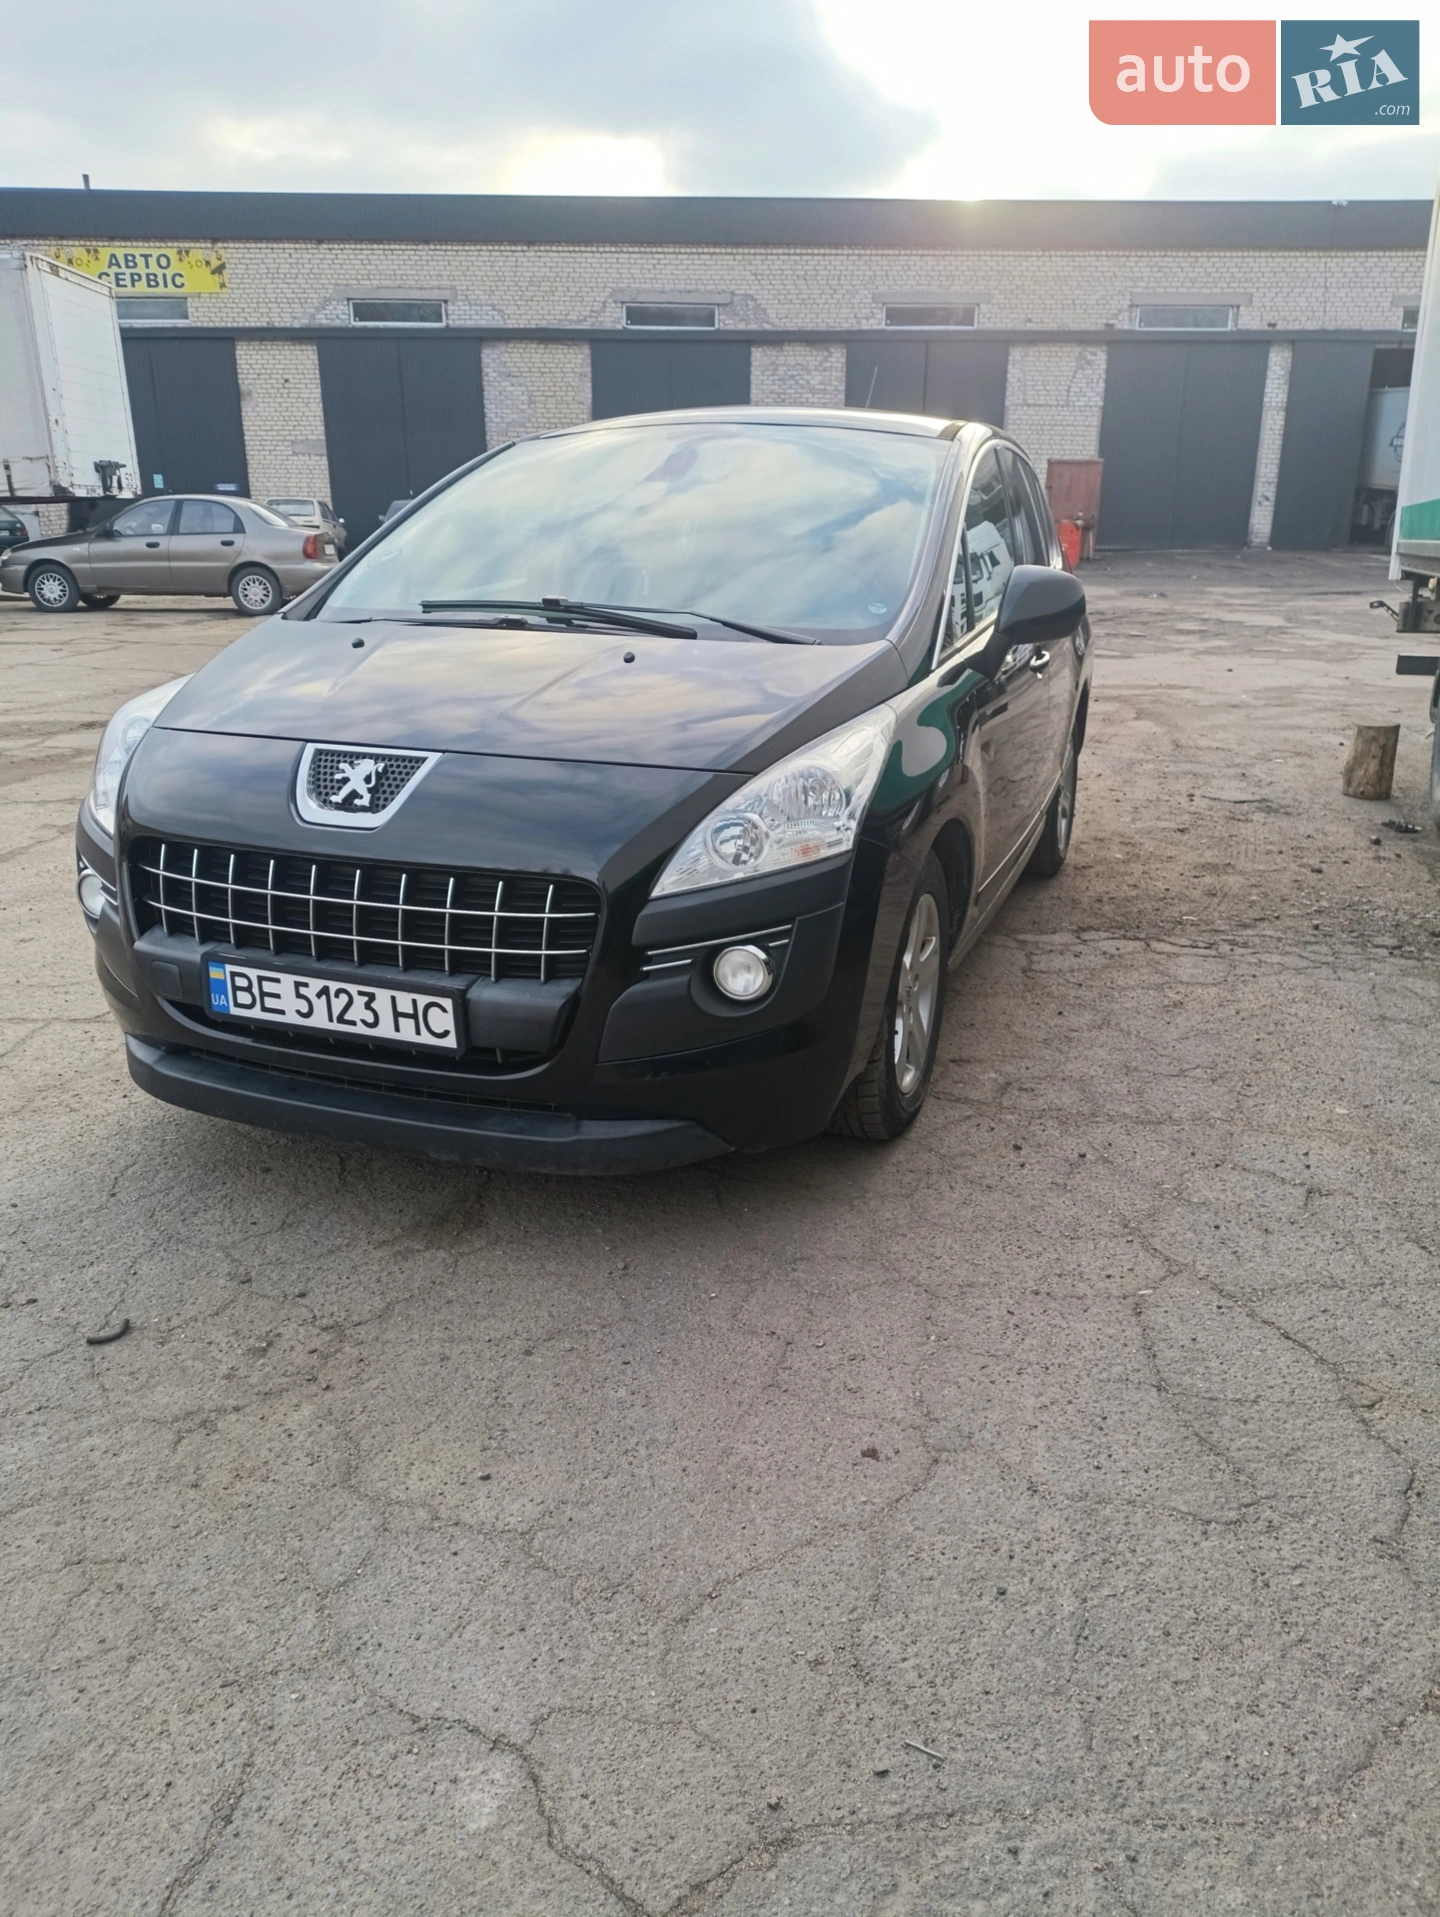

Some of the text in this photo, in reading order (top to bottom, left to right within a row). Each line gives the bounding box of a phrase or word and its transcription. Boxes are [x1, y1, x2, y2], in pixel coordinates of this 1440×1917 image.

[107, 253, 172, 270] АВТО
[211, 993, 228, 1007] UA
[229, 970, 451, 1039] BE 5123 HC
